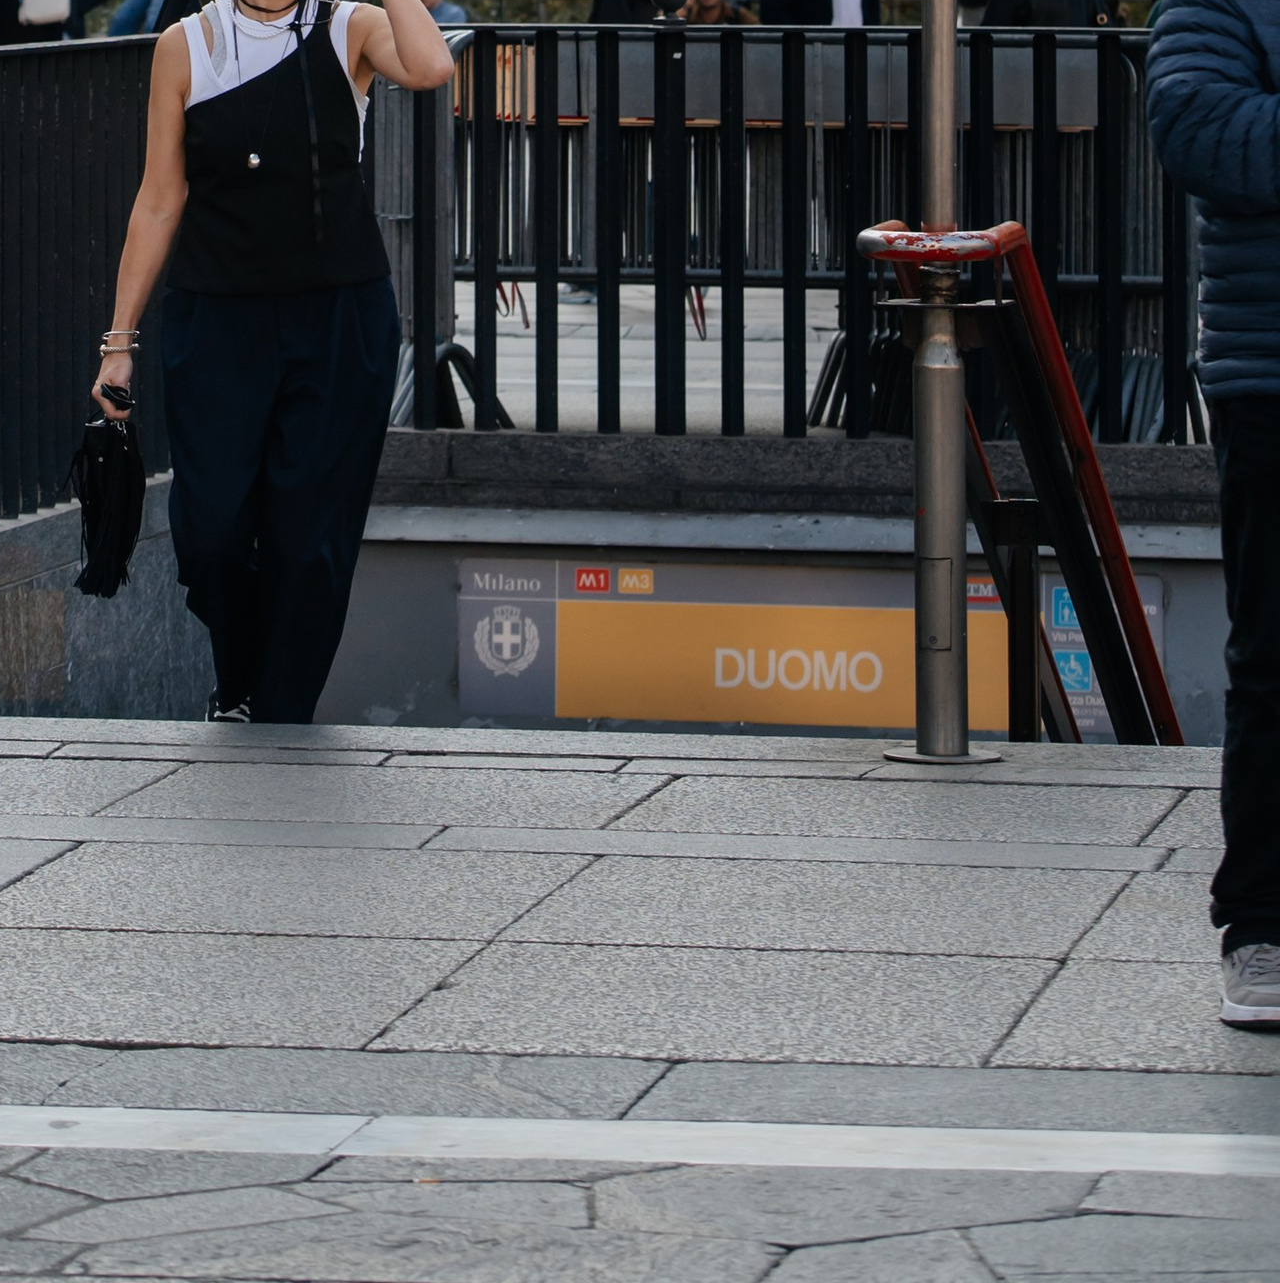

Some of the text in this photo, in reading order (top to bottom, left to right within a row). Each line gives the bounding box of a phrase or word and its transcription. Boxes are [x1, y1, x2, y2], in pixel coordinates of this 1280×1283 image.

[473, 572, 542, 592] Milano
[578, 572, 650, 589] M1 M3
[966, 583, 994, 597] TM
[714, 647, 884, 693] DUOMO
